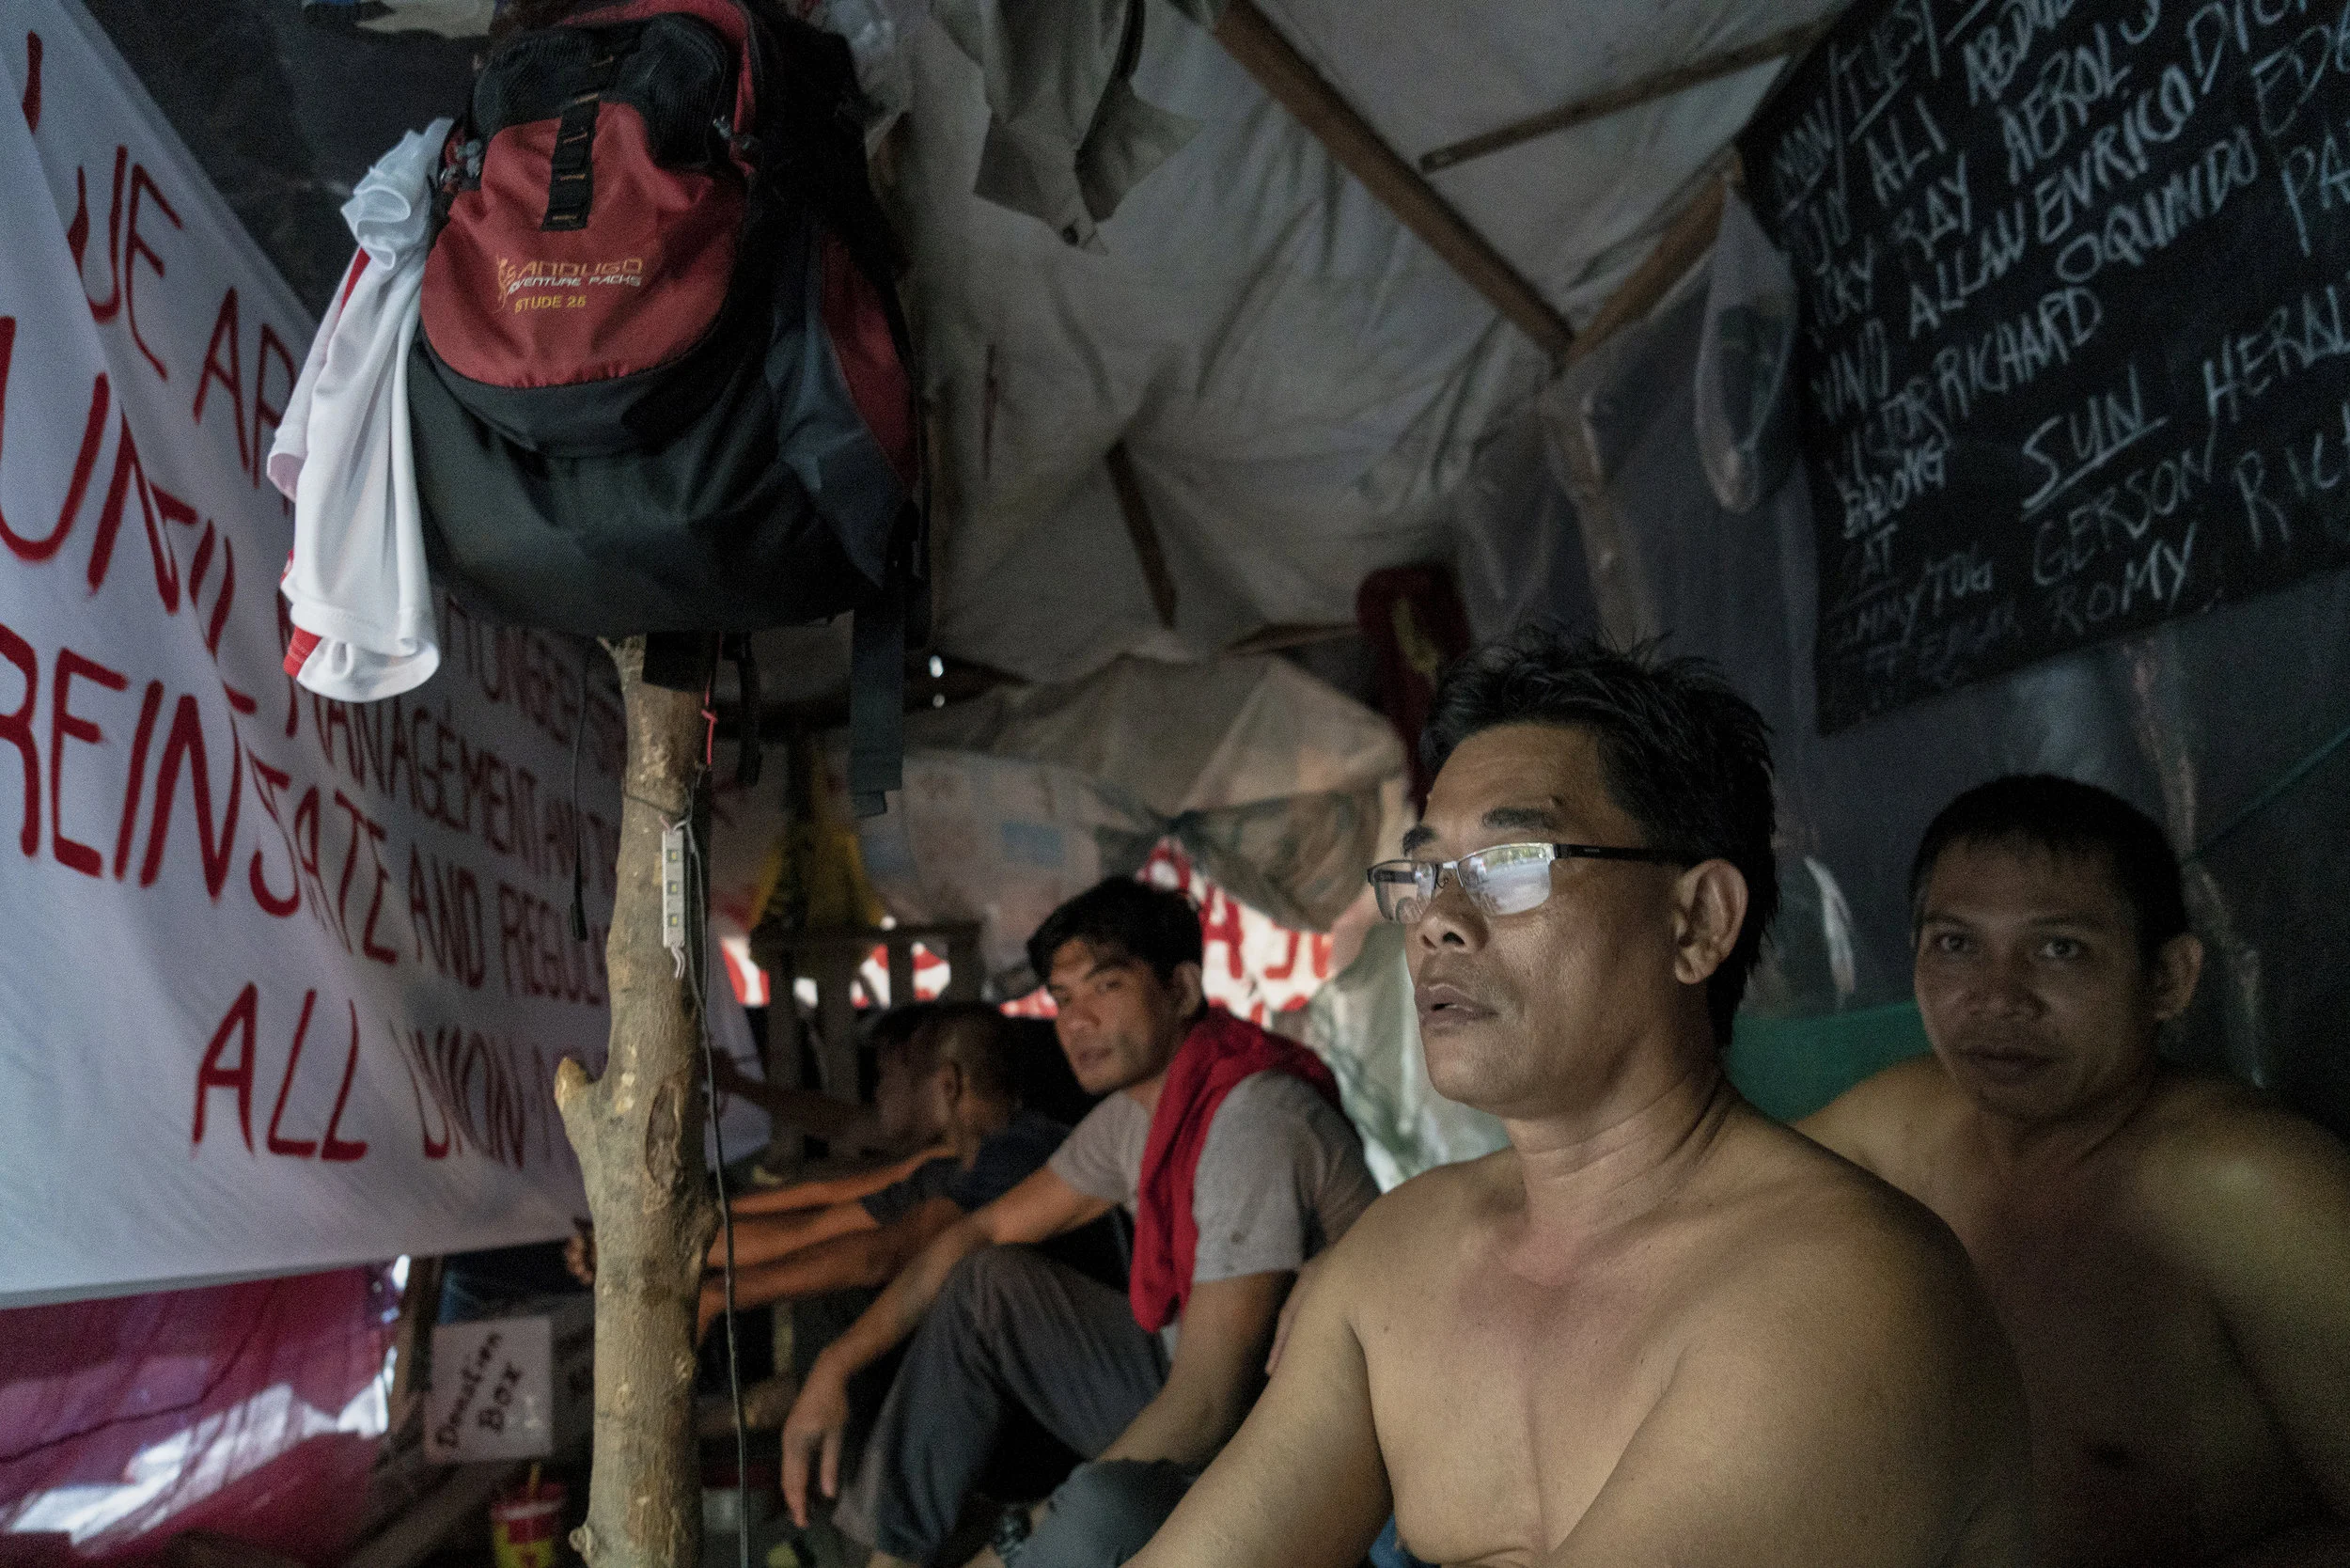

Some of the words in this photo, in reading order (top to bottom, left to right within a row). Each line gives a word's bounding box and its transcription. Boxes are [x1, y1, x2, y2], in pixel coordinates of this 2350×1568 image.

[1866, 92, 1948, 209] ALI
[1908, 199, 2027, 342] ALLAN
[193, 286, 299, 491] AR
[1932, 286, 2105, 421] RICHARD
[2020, 361, 2147, 510] SUN
[2047, 521, 2198, 635] ROMY
[409, 841, 487, 989] AND
[192, 981, 369, 1162] ALL
[478, 1362, 522, 1435] Box
